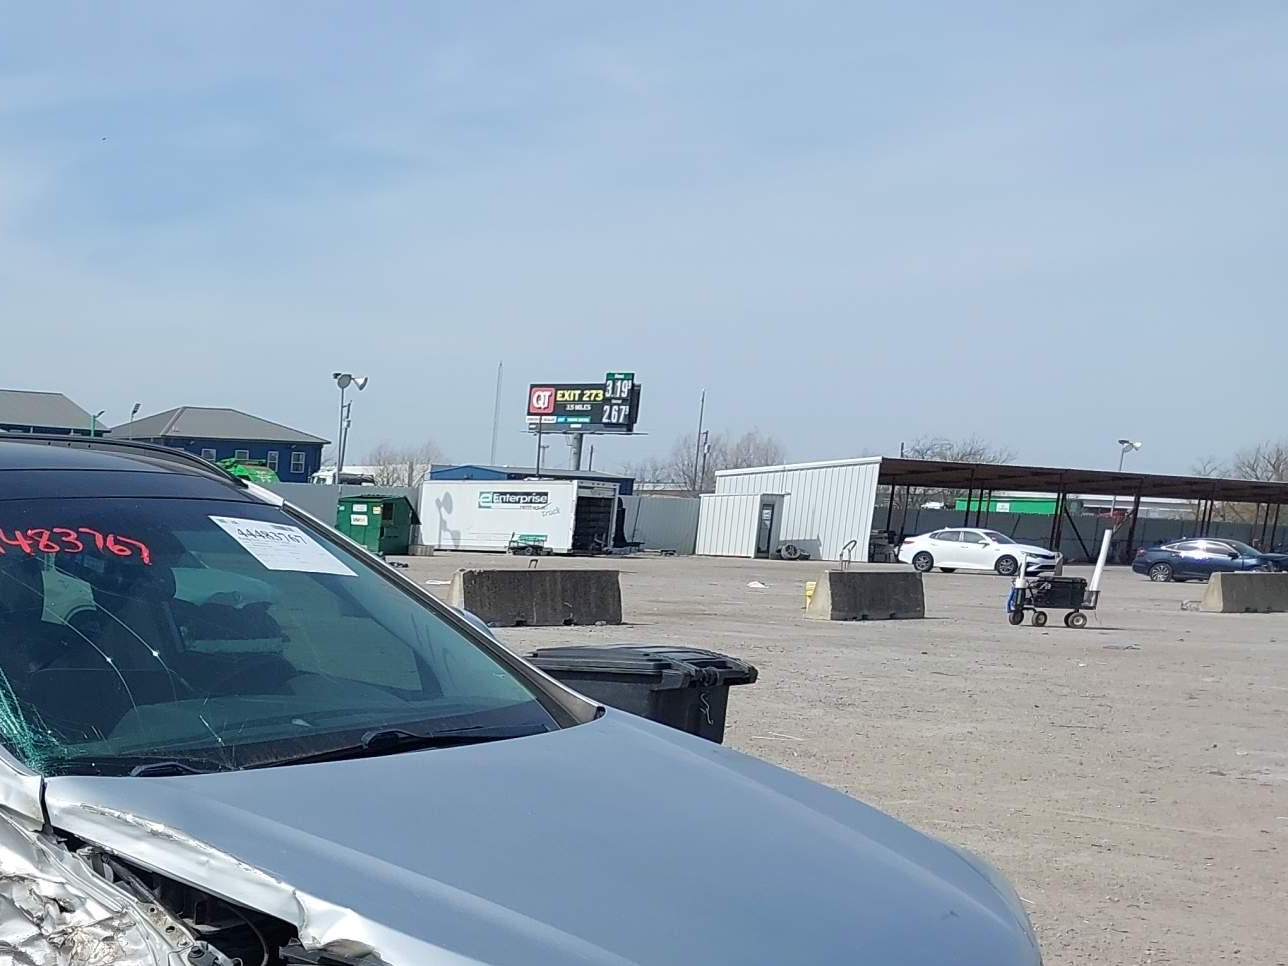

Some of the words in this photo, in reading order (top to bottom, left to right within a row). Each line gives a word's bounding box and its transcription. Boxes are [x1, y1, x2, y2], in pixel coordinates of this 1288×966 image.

[532, 391, 552, 410] QT
[556, 390, 582, 401] EXIT
[583, 390, 604, 401] 273
[493, 493, 548, 504] Enterprise
[237, 528, 307, 545] 44483767
